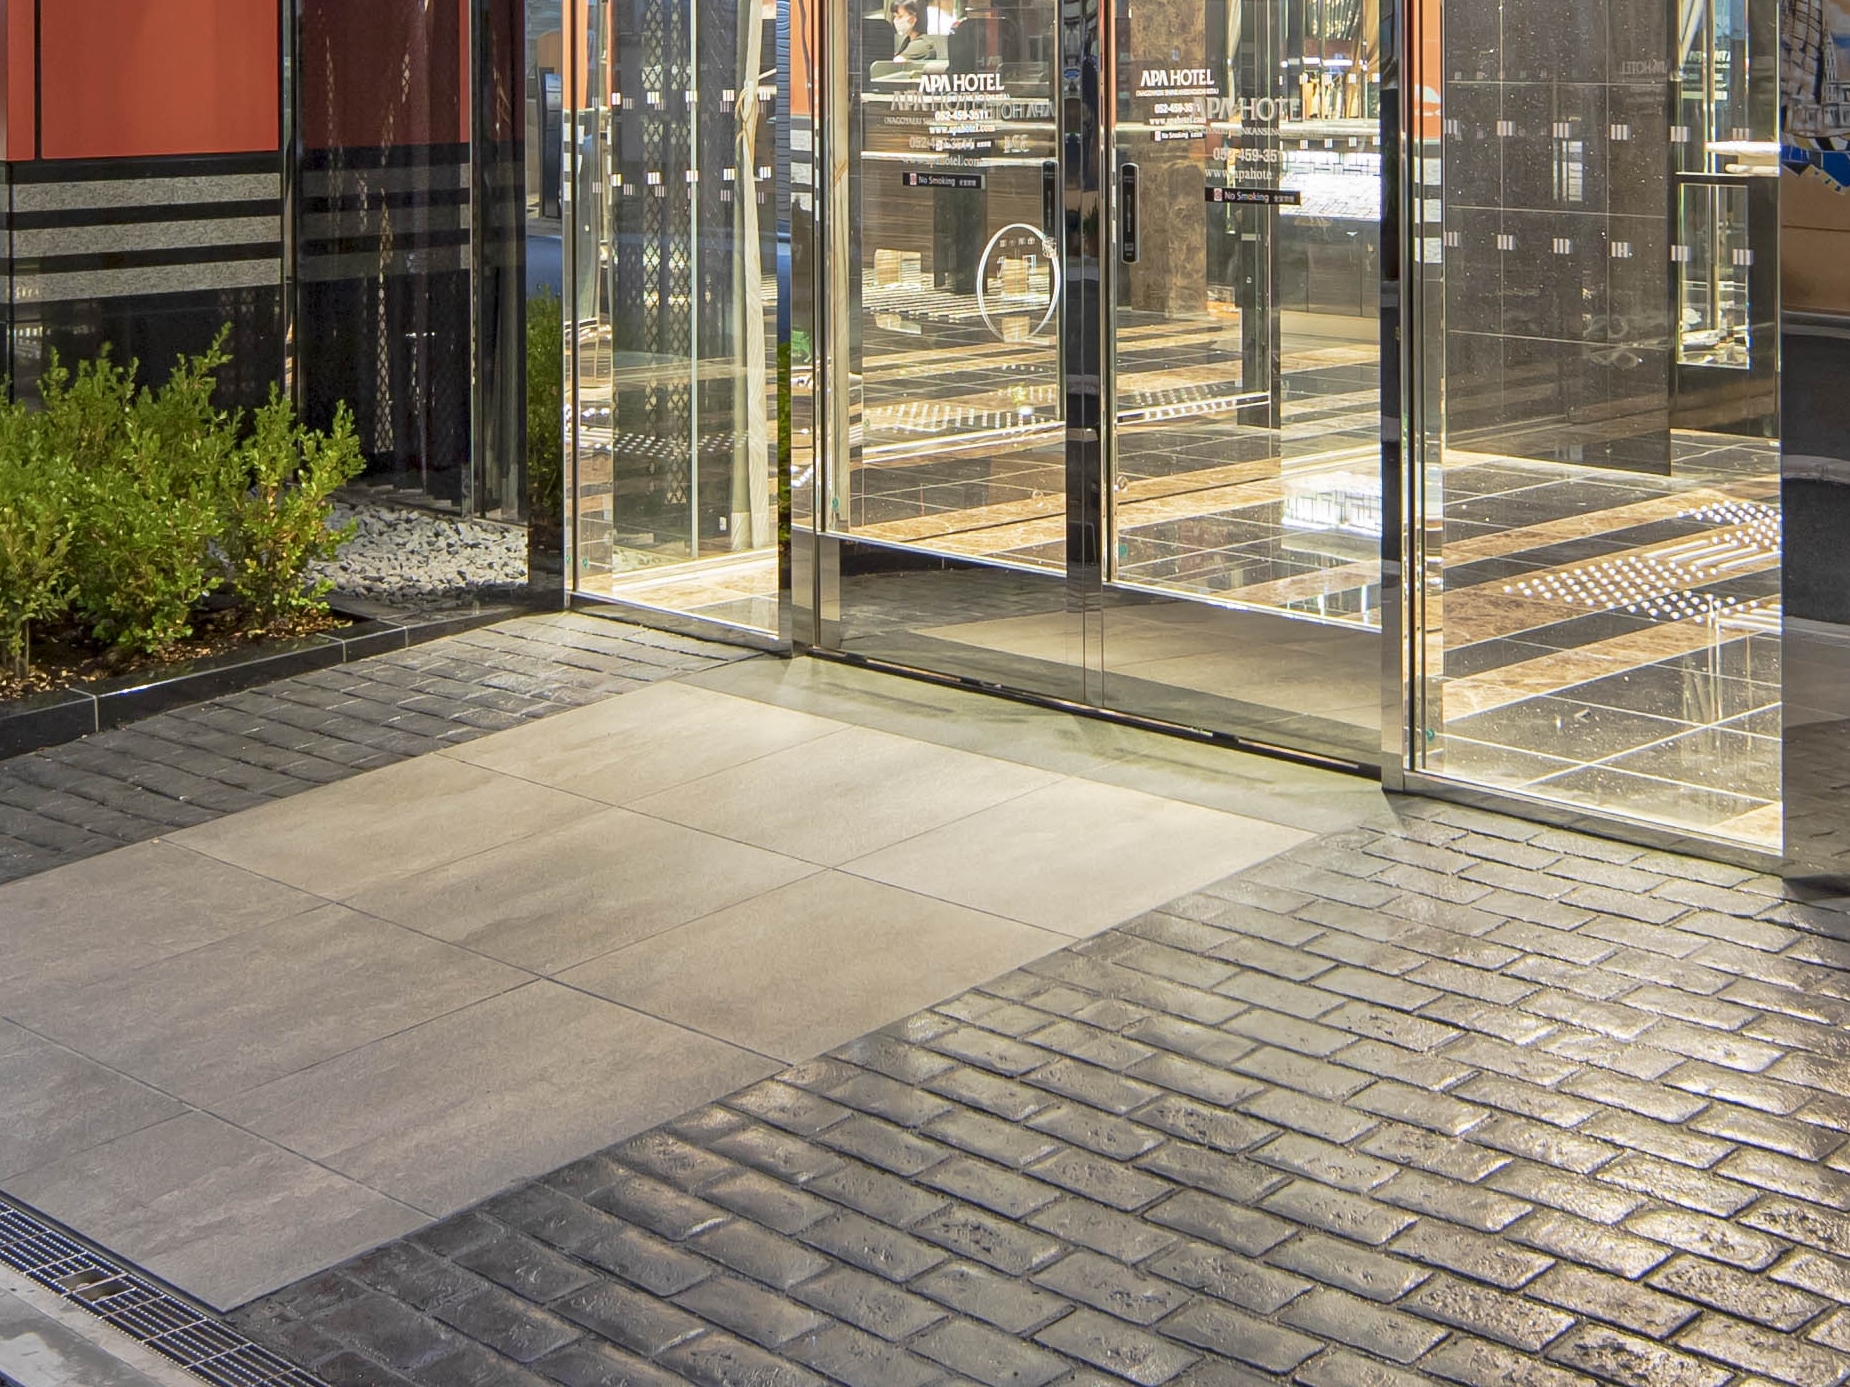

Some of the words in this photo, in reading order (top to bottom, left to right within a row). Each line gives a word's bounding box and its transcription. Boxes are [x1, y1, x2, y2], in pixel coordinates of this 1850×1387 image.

[918, 73, 950, 93] APA
[952, 72, 1005, 92] HOTEL
[1140, 69, 1168, 87] APA
[1170, 68, 1215, 86] HOTEL
[1240, 96, 1302, 122] HOTE
[1212, 147, 1278, 163] 052-459-35
[918, 176, 928, 185] No
[929, 176, 956, 187] Smoking
[1224, 191, 1236, 201] No
[1237, 191, 1270, 203] Smoking
